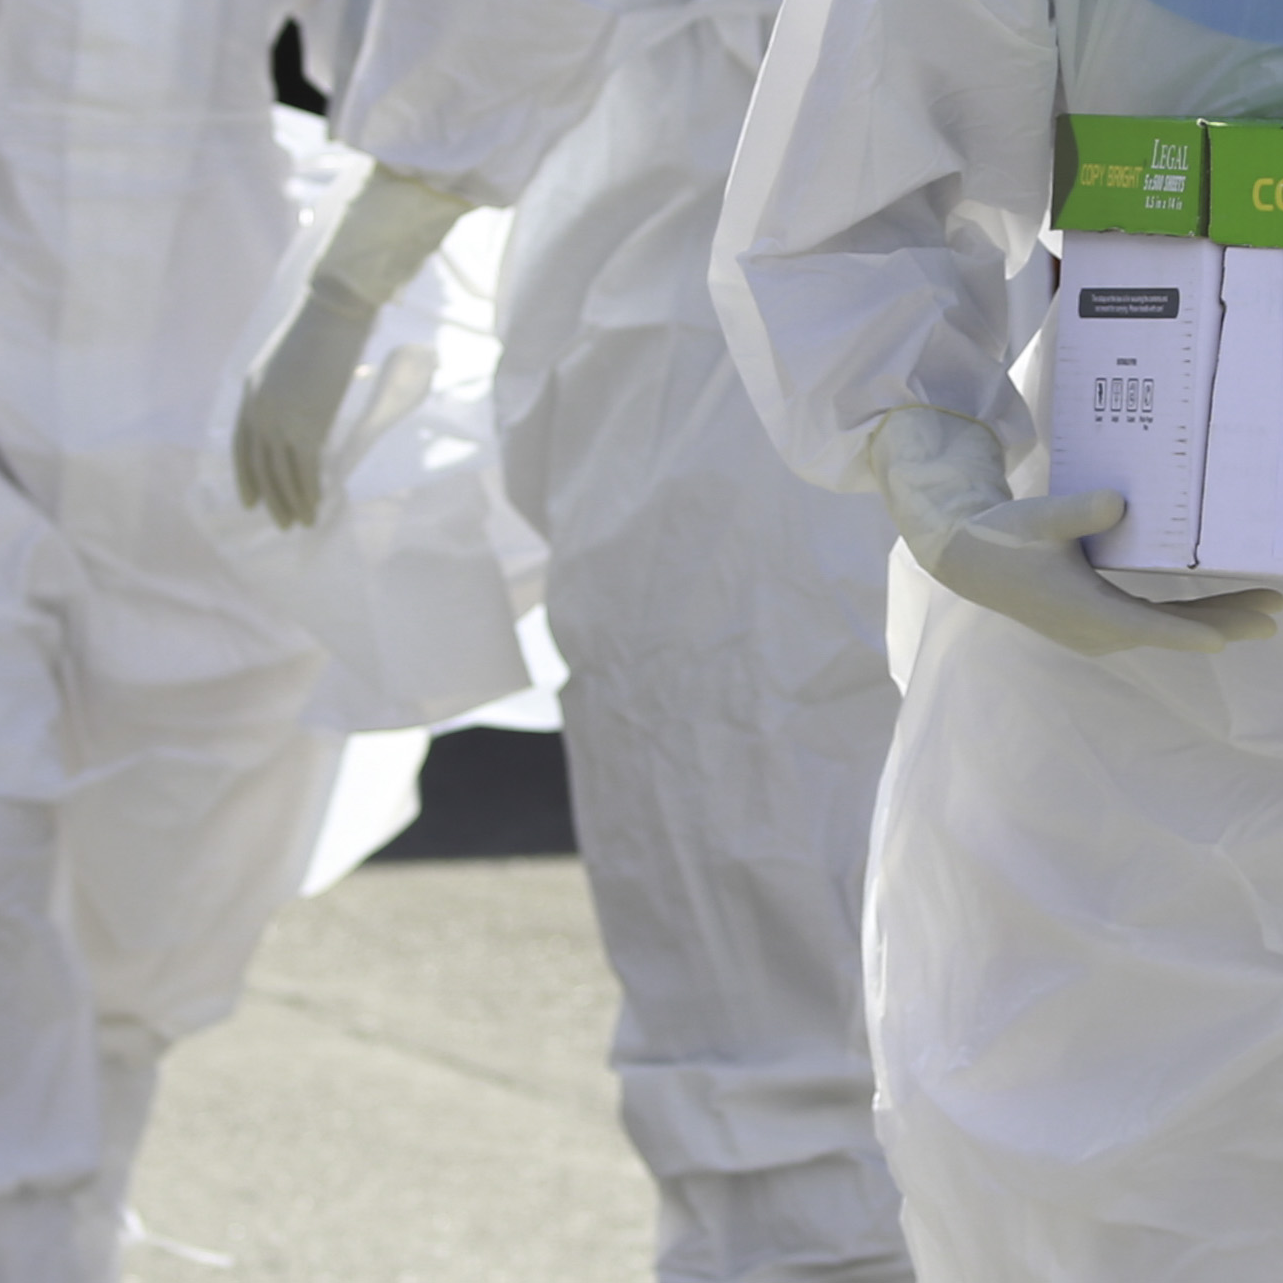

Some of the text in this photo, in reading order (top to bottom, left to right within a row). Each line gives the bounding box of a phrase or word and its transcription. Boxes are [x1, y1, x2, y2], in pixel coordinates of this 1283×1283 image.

[1151, 138, 1189, 171] LEGAL
[1081, 163, 1143, 189] COPY BRIGHT
